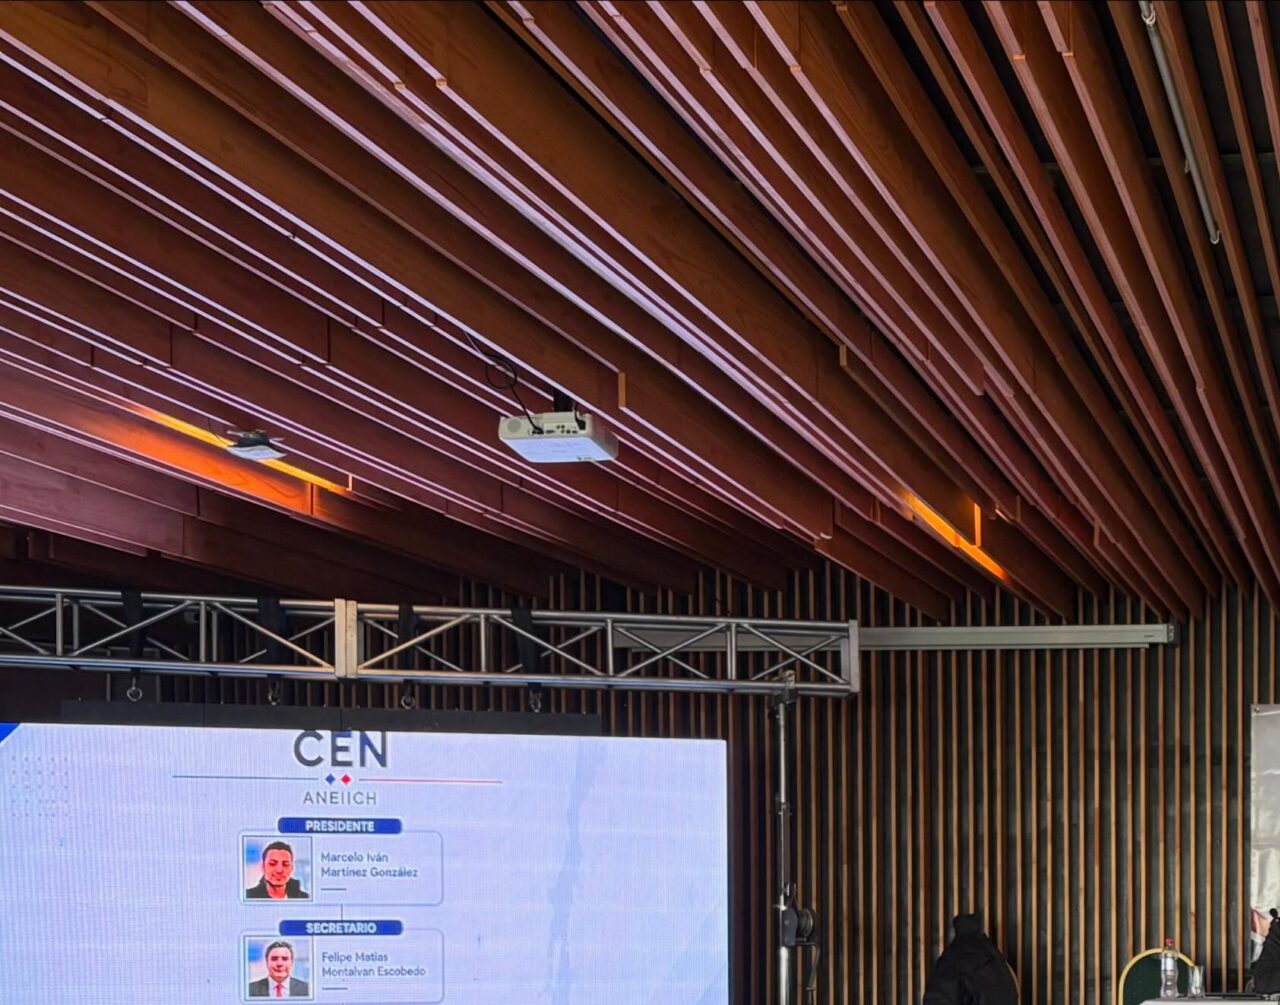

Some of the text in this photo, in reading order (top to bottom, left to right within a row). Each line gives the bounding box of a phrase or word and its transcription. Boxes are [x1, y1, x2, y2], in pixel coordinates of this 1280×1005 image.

[293, 729, 388, 767] CEN
[303, 791, 377, 805] ANEIICH
[305, 820, 375, 832] PRESIDENTE
[321, 851, 389, 863] Marcelo Iván
[370, 867, 419, 878] González
[306, 922, 377, 934] SECRETARIO
[322, 952, 352, 964] Felipe
[378, 966, 427, 977] Escobedo
